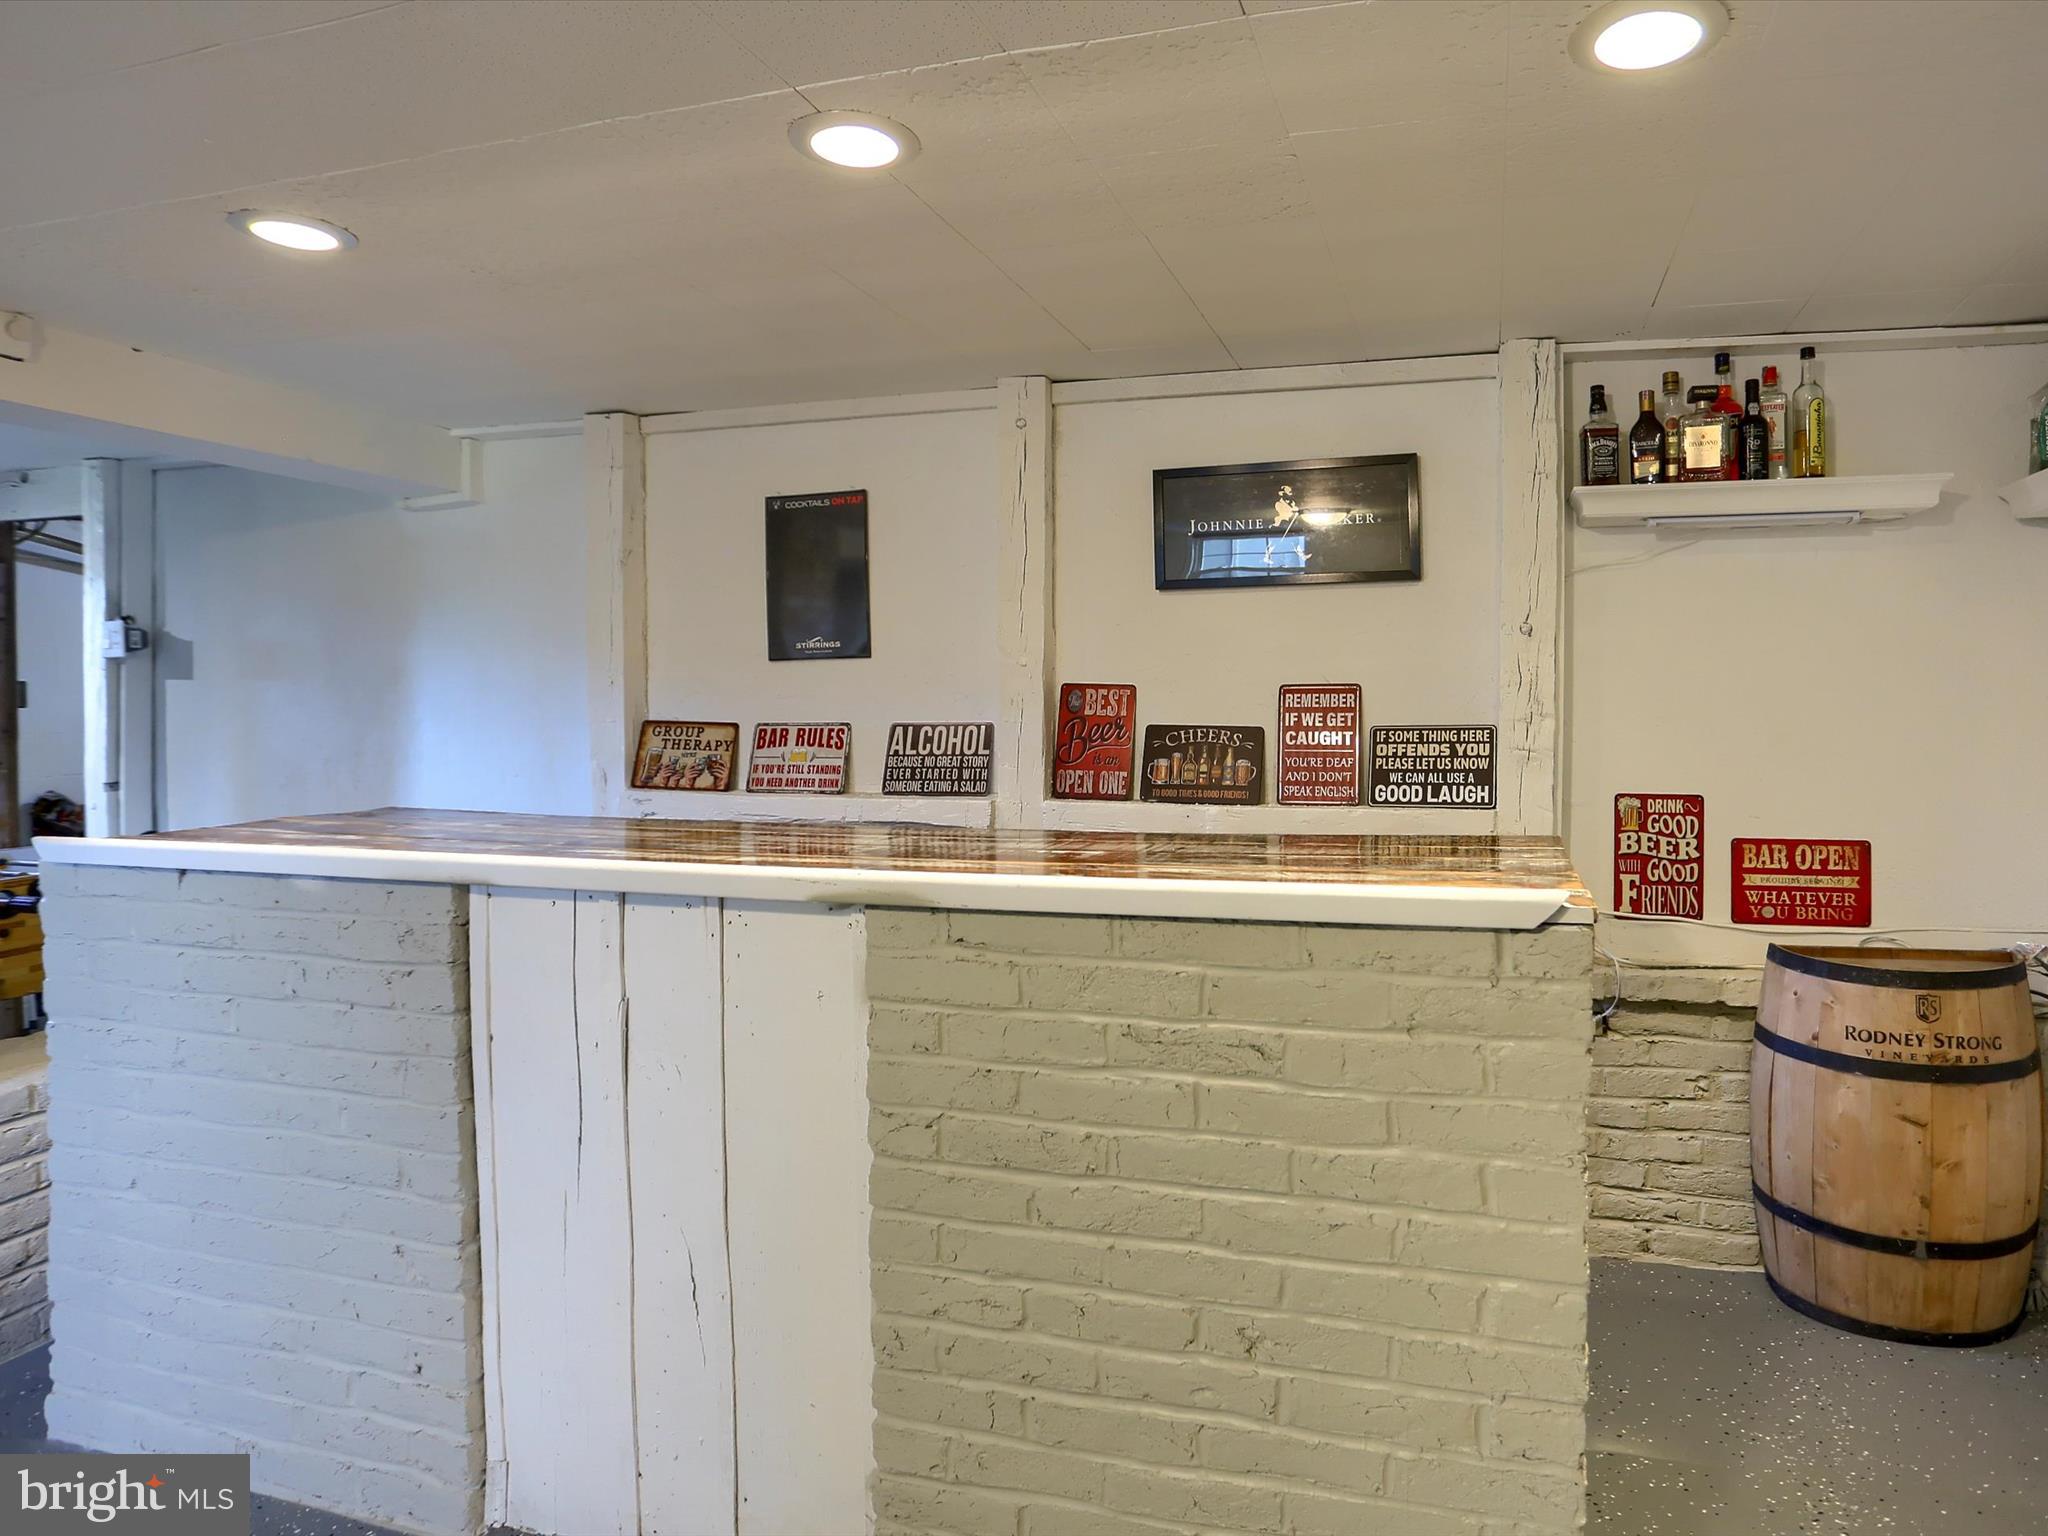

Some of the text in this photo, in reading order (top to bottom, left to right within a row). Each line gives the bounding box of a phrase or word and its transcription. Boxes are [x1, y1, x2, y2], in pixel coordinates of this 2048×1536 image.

[784, 495, 864, 509] COCKTAILS ON TAP
[1188, 518, 1264, 536] JOHNNIE
[795, 640, 841, 649] STIRRINGS
[1084, 688, 1131, 717] BEST
[1285, 693, 1355, 708] REMEMBER
[1285, 712, 1355, 727] IF WE GET
[652, 725, 705, 738] GROUP
[756, 727, 845, 750] BAR RULES
[1165, 728, 1243, 747] CHEERS
[1285, 731, 1354, 746] CAUGHT
[1376, 730, 1387, 742] IF
[1460, 730, 1490, 742] HERE
[661, 738, 735, 752] THERAPY
[889, 725, 990, 755] ALCOHOL
[1059, 717, 1131, 766] Beer
[1376, 743, 1490, 757] OFFENDS YOU
[752, 764, 842, 775] IF YOU'RE STILL STANDING
[887, 756, 990, 768] BECAUSE NO GREAT STORY
[1285, 757, 1354, 768] YOU'RE DEAF
[1375, 757, 1490, 770] PLEASE LET US KNOW
[886, 768, 988, 780] EVER STARTED WITH
[1285, 771, 1352, 782] AND I DON'T
[1389, 772, 1475, 784] WE CAN ALL USE A
[751, 777, 840, 789] YOU NEED ANOTHER DRINK
[884, 780, 987, 793] SOMEONE EATING A SALAD
[1056, 769, 1128, 795] OPEN ONE
[1283, 785, 1354, 797] SPEAK ENGLISH
[1374, 784, 1489, 803] GOOD LAUGH
[1647, 798, 1684, 814] DRINK
[1647, 814, 1699, 839] GOOD
[1618, 831, 1700, 860] BEER
[1742, 843, 1860, 871] BAR OPEN
[1646, 858, 1699, 883] GOOD
[1618, 873, 1699, 916] FRIENDS
[1744, 890, 1857, 906] WHATEVER
[1749, 905, 1854, 921] YOU BRING
[1844, 1024, 2003, 1051] RODNEY STRONG
